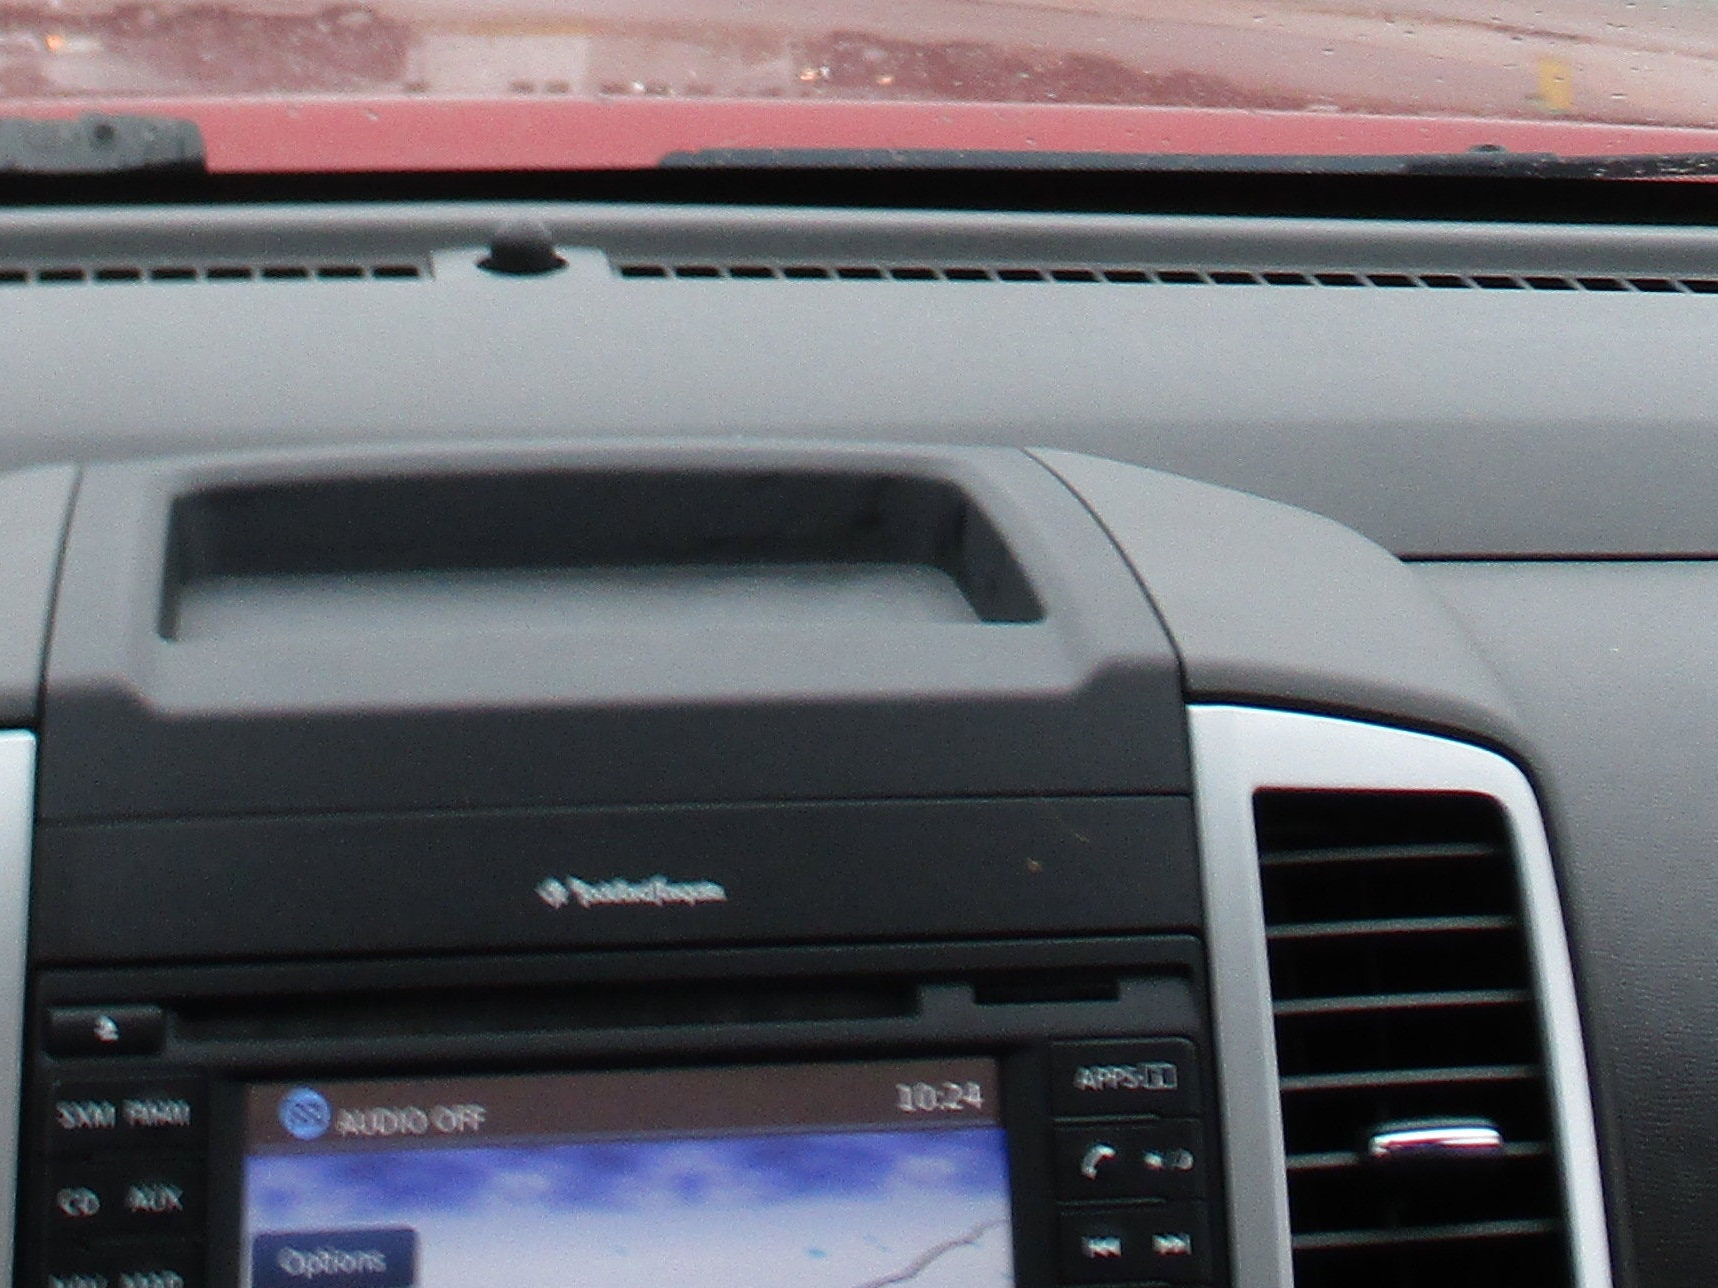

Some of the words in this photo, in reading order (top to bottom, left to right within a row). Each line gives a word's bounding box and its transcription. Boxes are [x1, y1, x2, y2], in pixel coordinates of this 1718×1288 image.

[894, 1081, 984, 1113] 10:24
[336, 1106, 429, 1137] AUDIO
[430, 1103, 486, 1135] OFF
[56, 1185, 102, 1217] CD
[124, 1182, 184, 1213] AUX
[277, 1245, 388, 1280] Options
